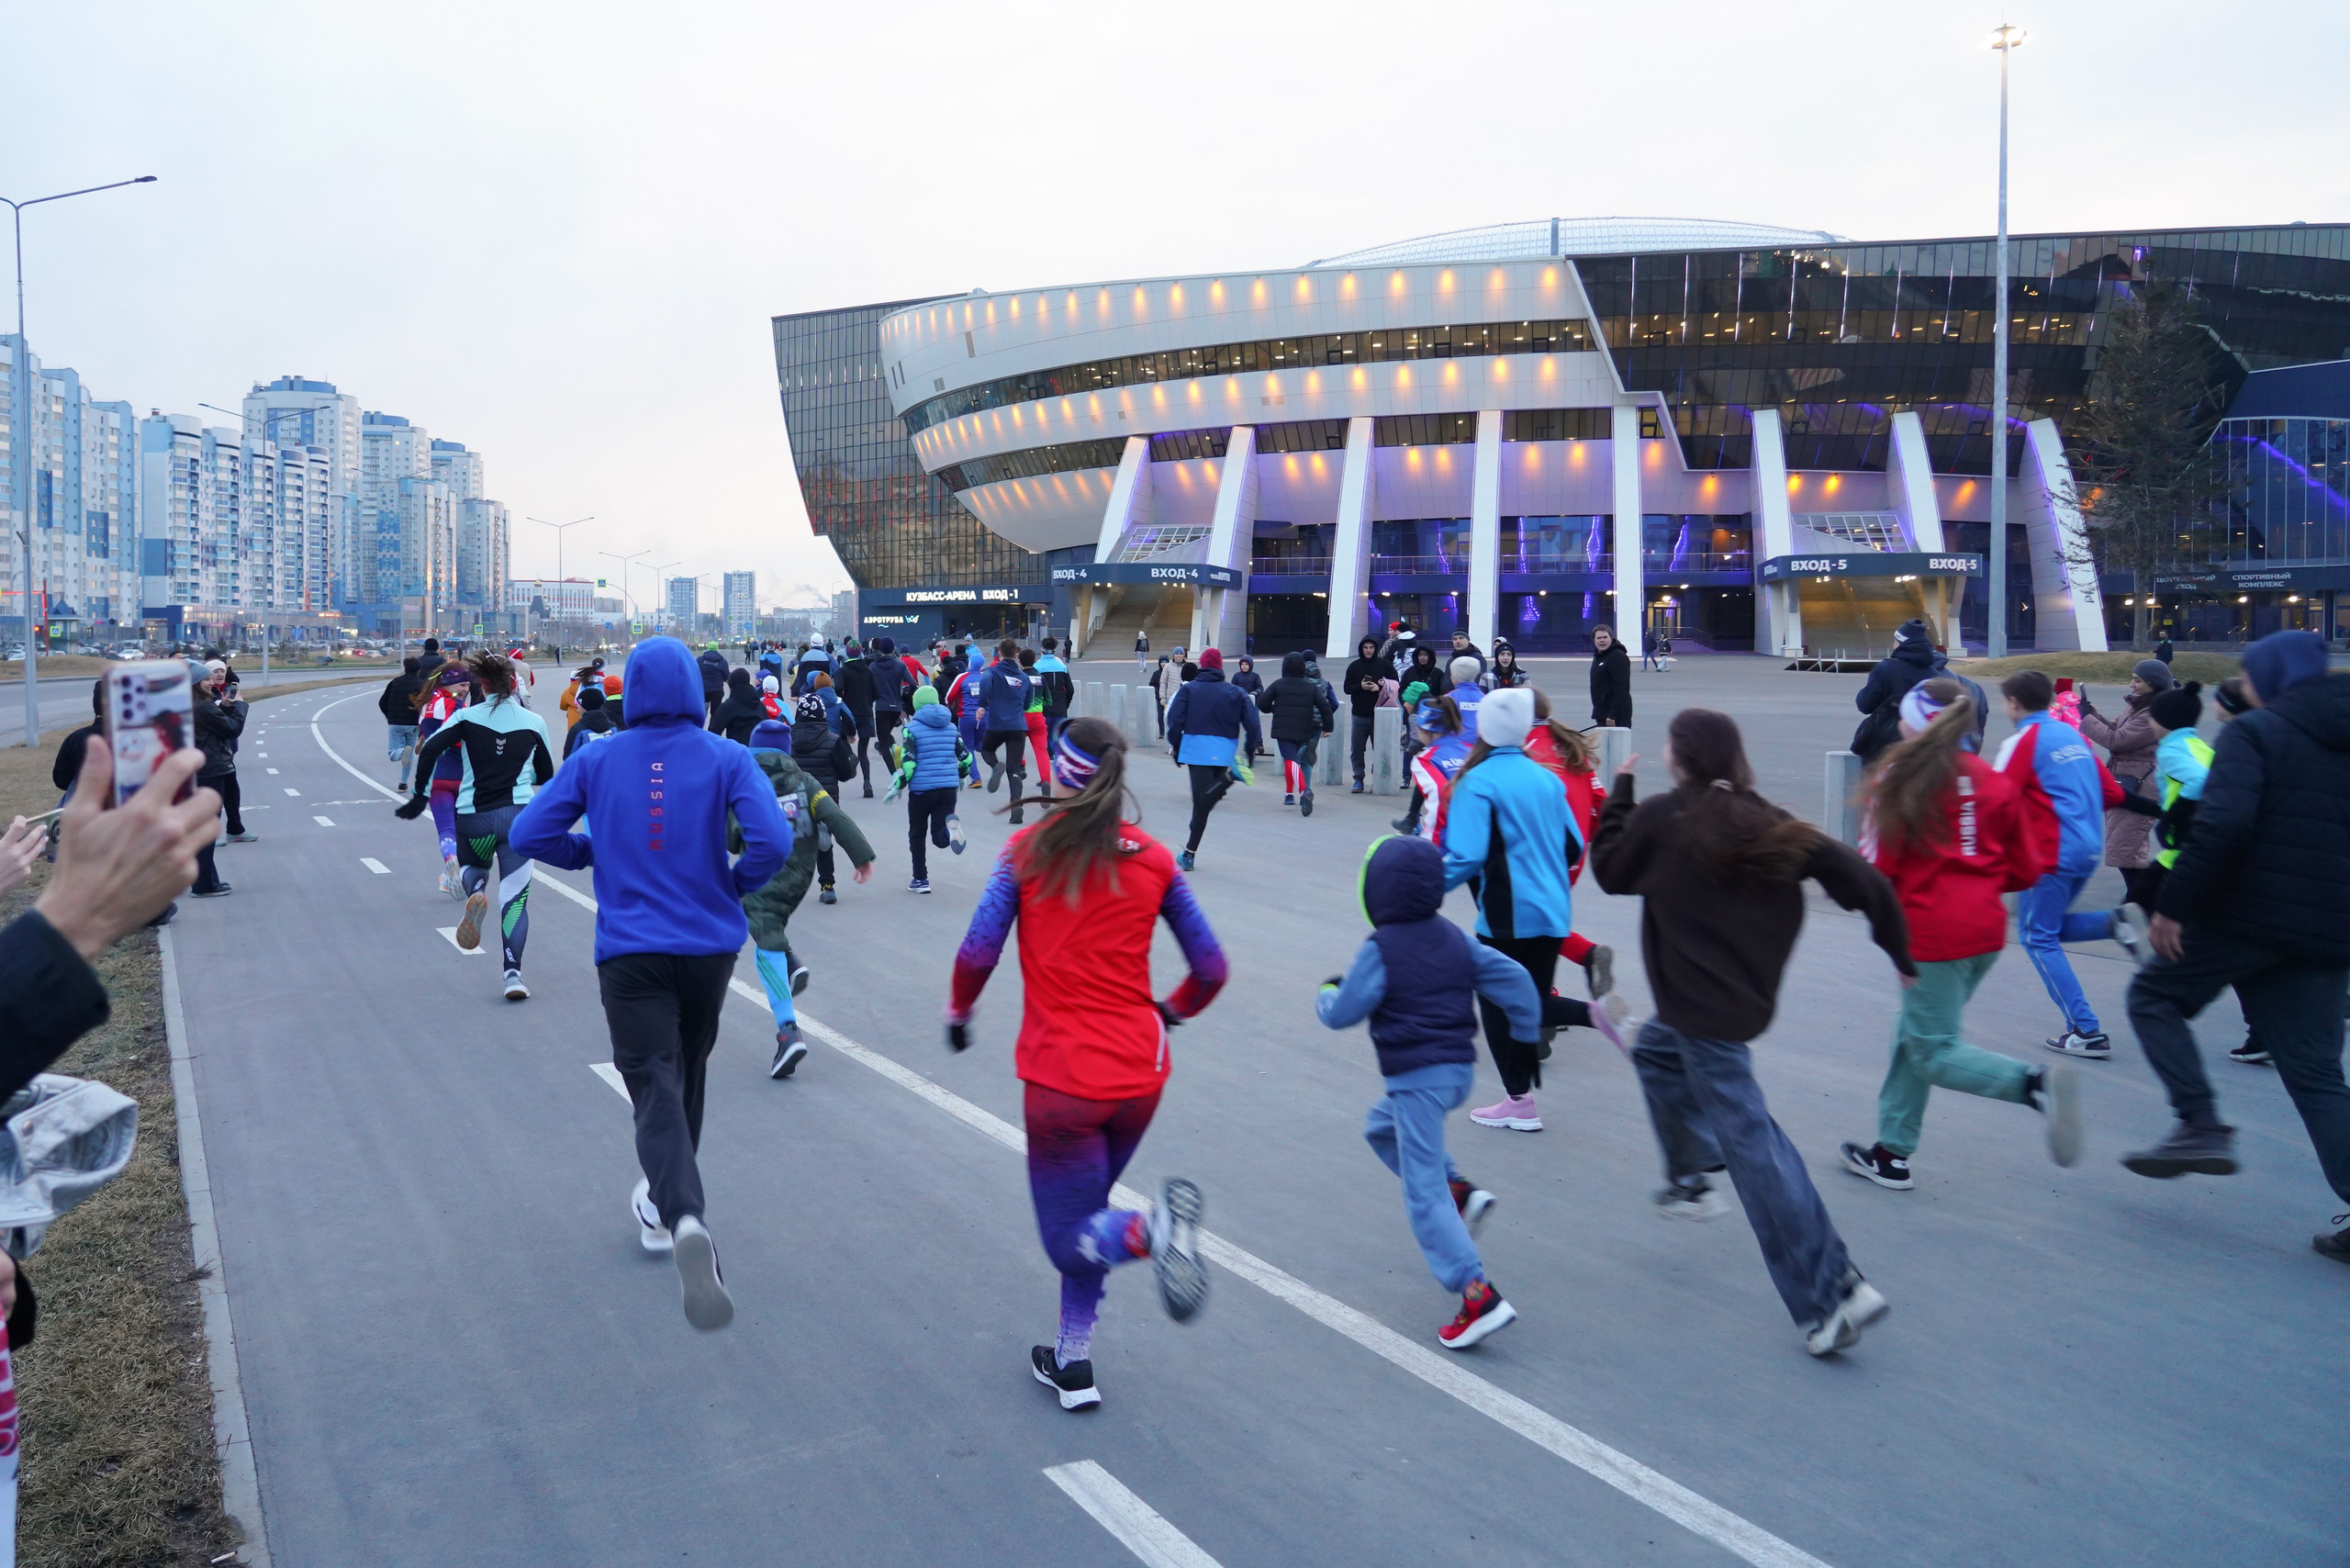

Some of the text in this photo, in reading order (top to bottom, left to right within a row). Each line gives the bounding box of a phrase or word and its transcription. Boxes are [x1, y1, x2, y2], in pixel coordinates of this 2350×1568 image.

[1791, 559, 1847, 572] ВХОД-5
[1929, 558, 1976, 571] ВХОД-5
[1053, 568, 1088, 580] ВХОД-4
[1151, 567, 1199, 578] ВХОД-4
[2232, 571, 2291, 581] СПОРТИВНЫЙ
[906, 590, 977, 602] КУЗБАСС-АРЕНА
[864, 616, 904, 624] АЭРОТРУБА
[650, 762, 665, 850] RUSSIA
[1959, 801, 1977, 857] RUSSIA
